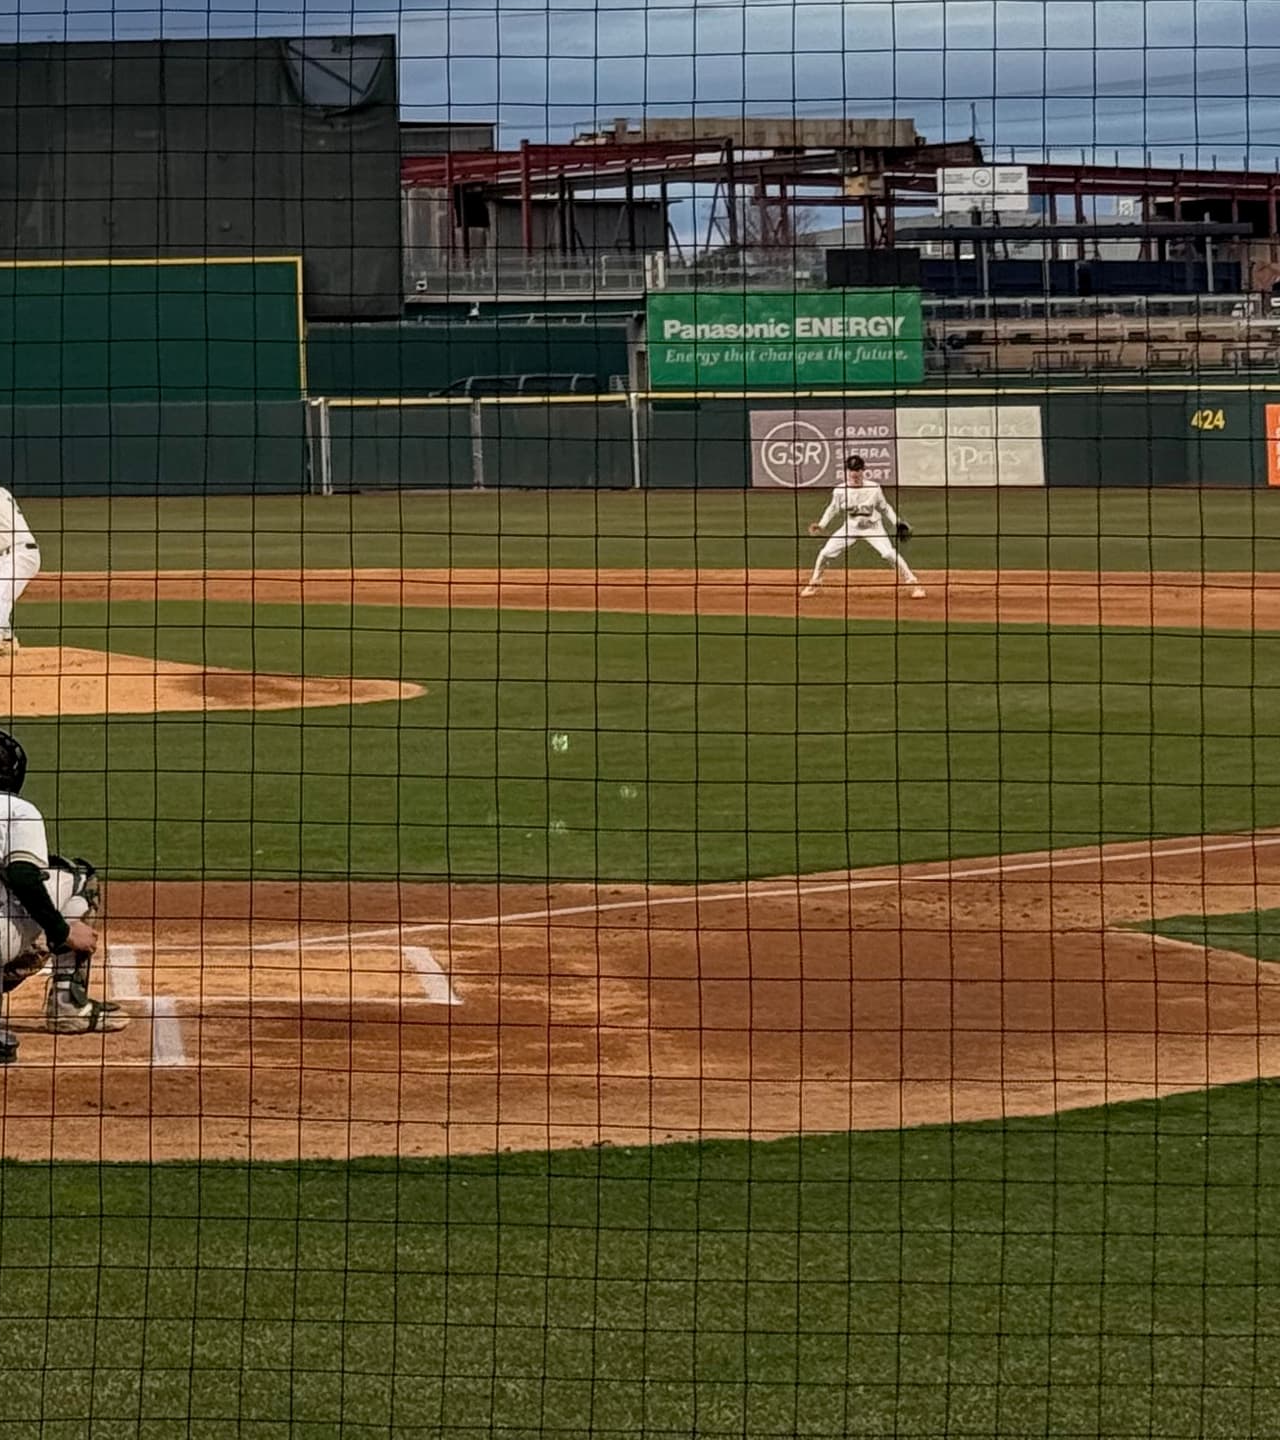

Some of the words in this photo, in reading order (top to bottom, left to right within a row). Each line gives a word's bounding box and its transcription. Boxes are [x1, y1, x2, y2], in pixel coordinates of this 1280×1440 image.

[663, 318, 790, 340] Panasonic
[795, 316, 906, 338] ENERGY
[665, 348, 720, 366] Energy
[724, 347, 755, 362] that
[761, 347, 824, 366] changes
[827, 346, 852, 361] the
[852, 345, 909, 364] future.
[1190, 408, 1225, 429] 424
[834, 426, 889, 437] GRAND
[767, 441, 822, 465] GSR
[835, 447, 890, 460] SIERRA
[836, 469, 891, 480] RORT
